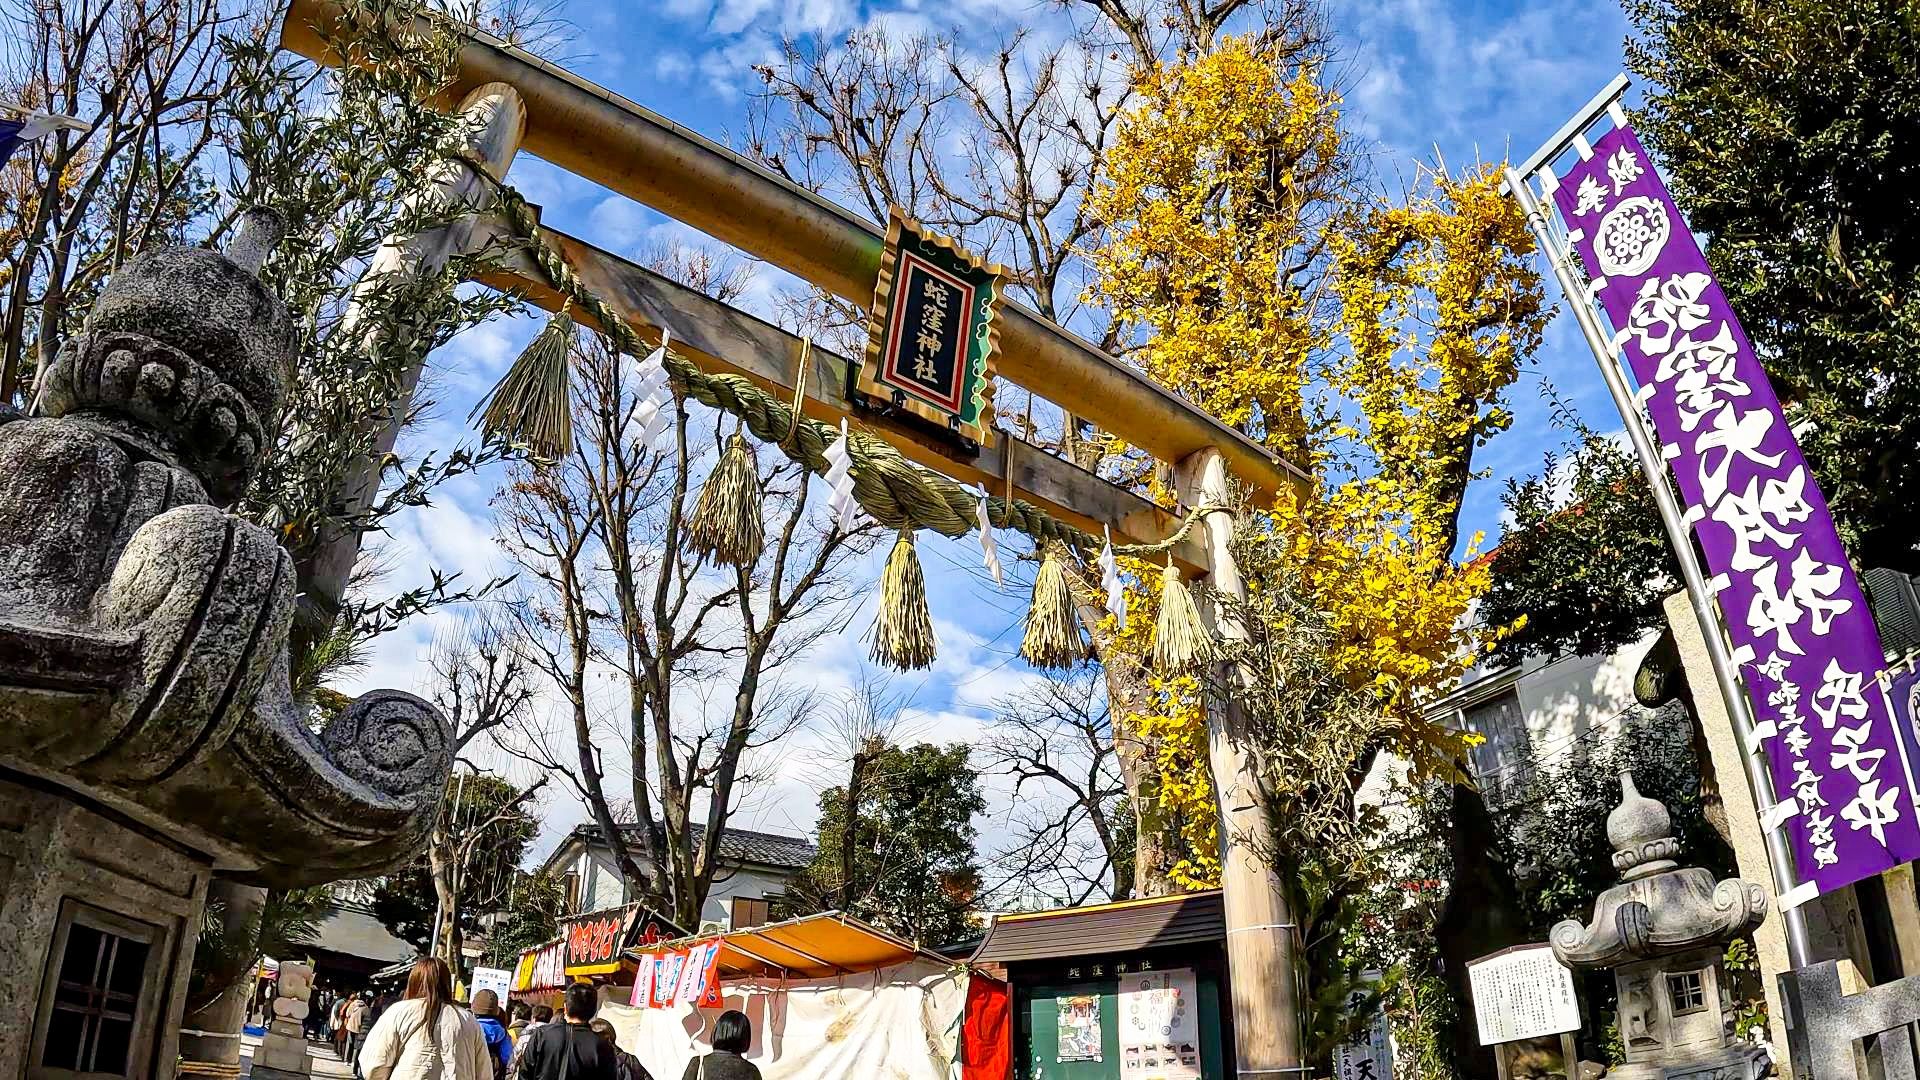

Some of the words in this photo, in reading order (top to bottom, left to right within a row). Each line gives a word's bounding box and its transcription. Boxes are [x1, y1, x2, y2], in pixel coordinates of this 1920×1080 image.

[912, 278, 950, 384] 蛇窪神社
[569, 917, 621, 964] やきそば
[1068, 960, 1153, 979] 蛇窪神社
